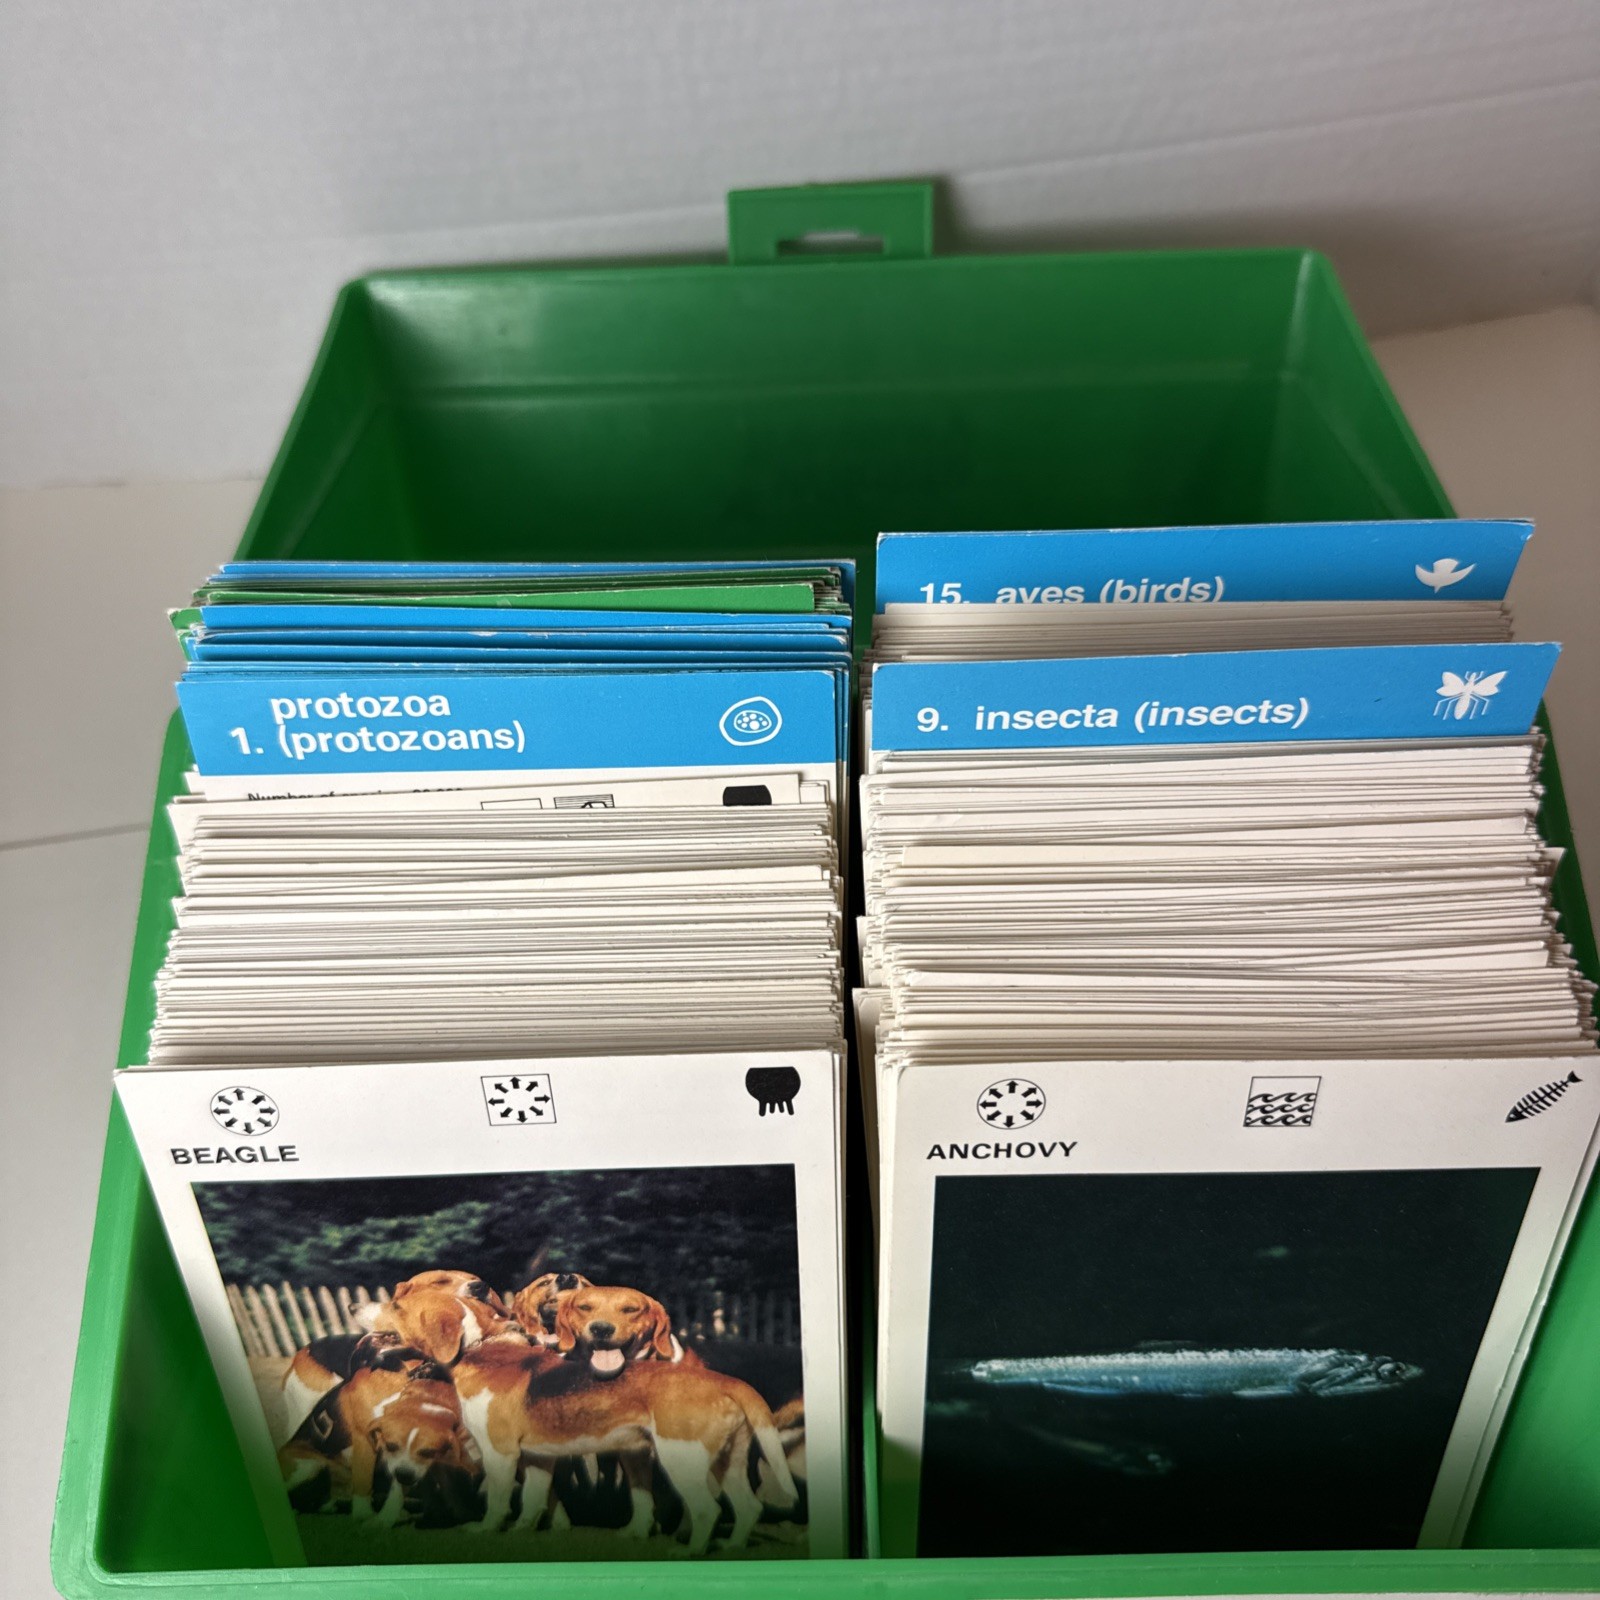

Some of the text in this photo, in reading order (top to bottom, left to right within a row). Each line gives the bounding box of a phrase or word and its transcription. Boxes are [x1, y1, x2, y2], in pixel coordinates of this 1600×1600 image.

[996, 586, 1085, 604] aves
[1100, 575, 1225, 603] (birds)
[270, 692, 451, 725] protozoa
[916, 697, 1309, 733] 9. insecta (insects)
[230, 720, 526, 760] 1. (protozoans)
[170, 1145, 300, 1165] BEAGLE
[926, 1141, 1078, 1159] ANCHOVY
